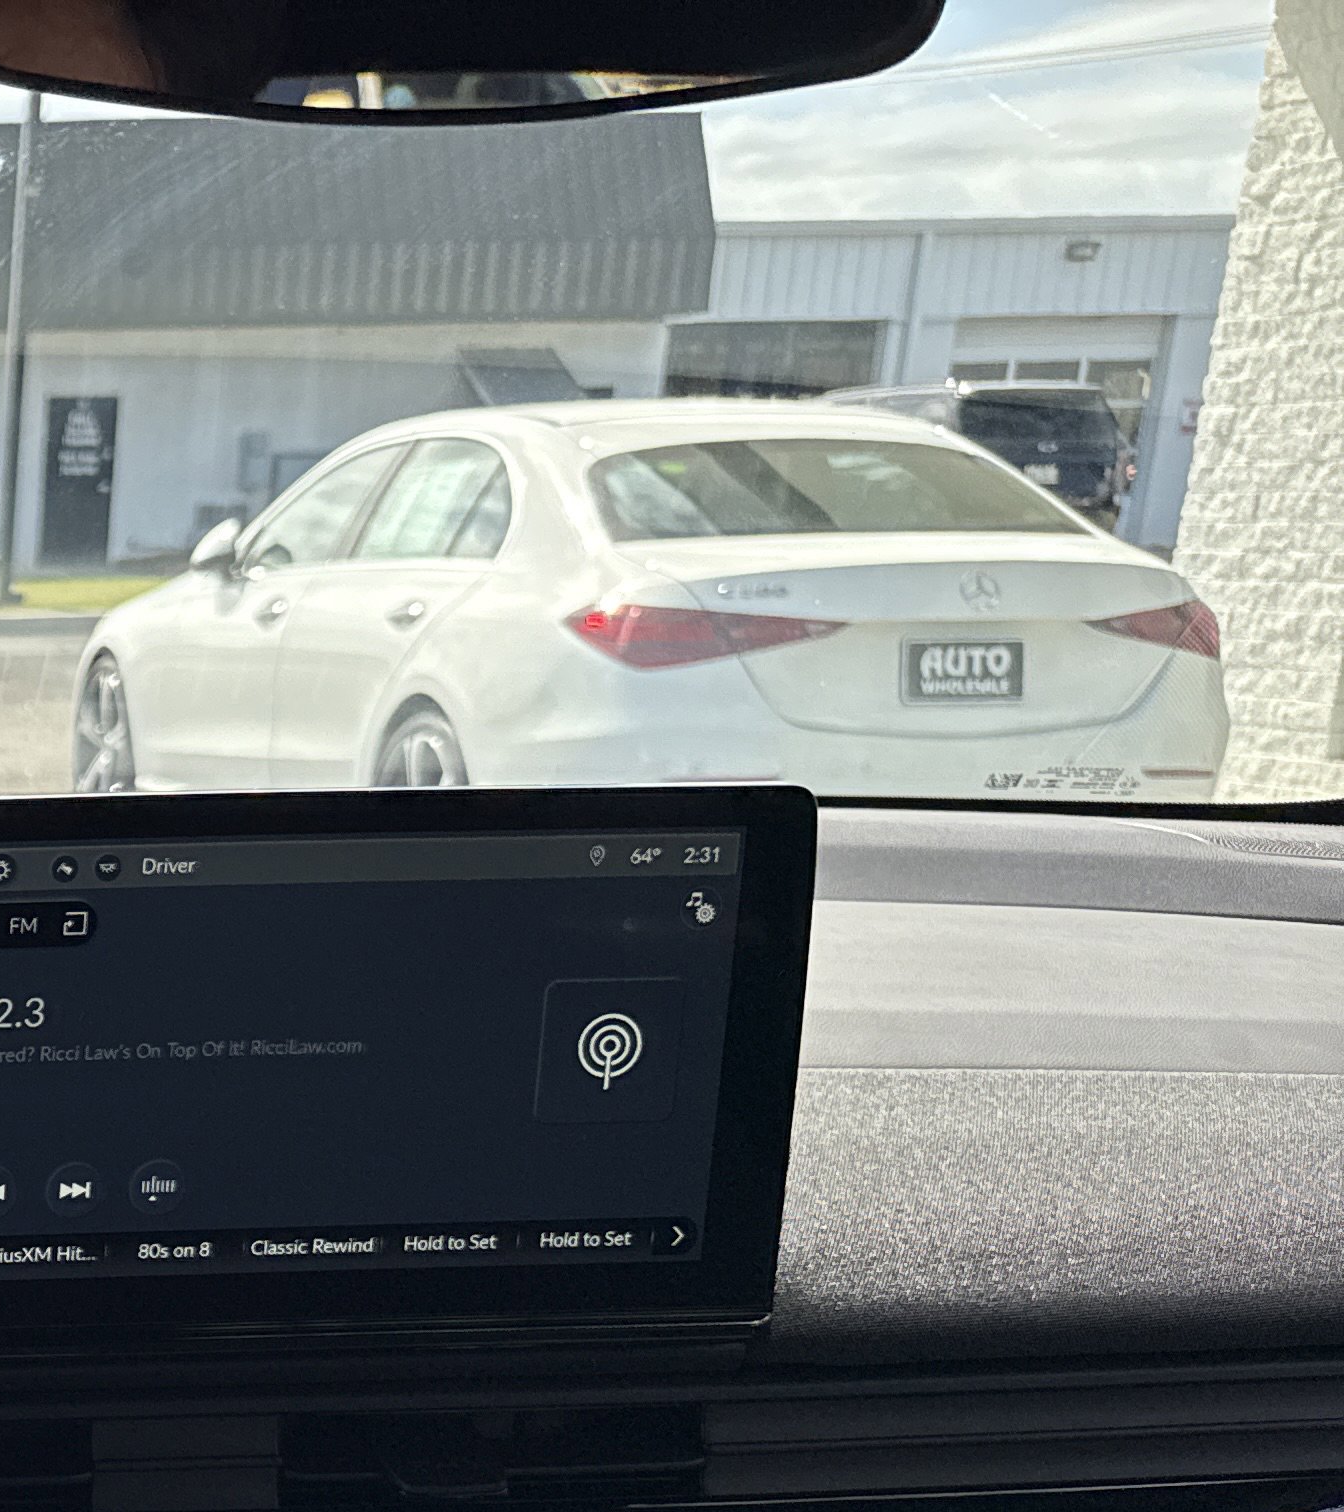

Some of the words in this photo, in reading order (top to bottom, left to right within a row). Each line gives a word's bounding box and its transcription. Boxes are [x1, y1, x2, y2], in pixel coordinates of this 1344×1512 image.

[920, 645, 1011, 678] AUTO
[683, 846, 721, 864] 2:31
[142, 858, 196, 875] Driver
[9, 917, 39, 934] FM
[40, 1045, 80, 1062] Ricci
[84, 1044, 131, 1061] Law's
[136, 1043, 161, 1058] On
[167, 1042, 197, 1060] Top
[202, 1040, 225, 1056] Of
[250, 1239, 309, 1255] Classic
[312, 1238, 375, 1254] Rewind
[403, 1235, 444, 1251] Hold
[448, 1236, 465, 1250] to
[468, 1234, 498, 1250] Set
[540, 1232, 580, 1248] Hold
[583, 1233, 600, 1247] to
[603, 1231, 633, 1247] Set
[137, 1243, 169, 1259] 80s
[172, 1246, 195, 1258] on
[198, 1241, 211, 1256] 8
